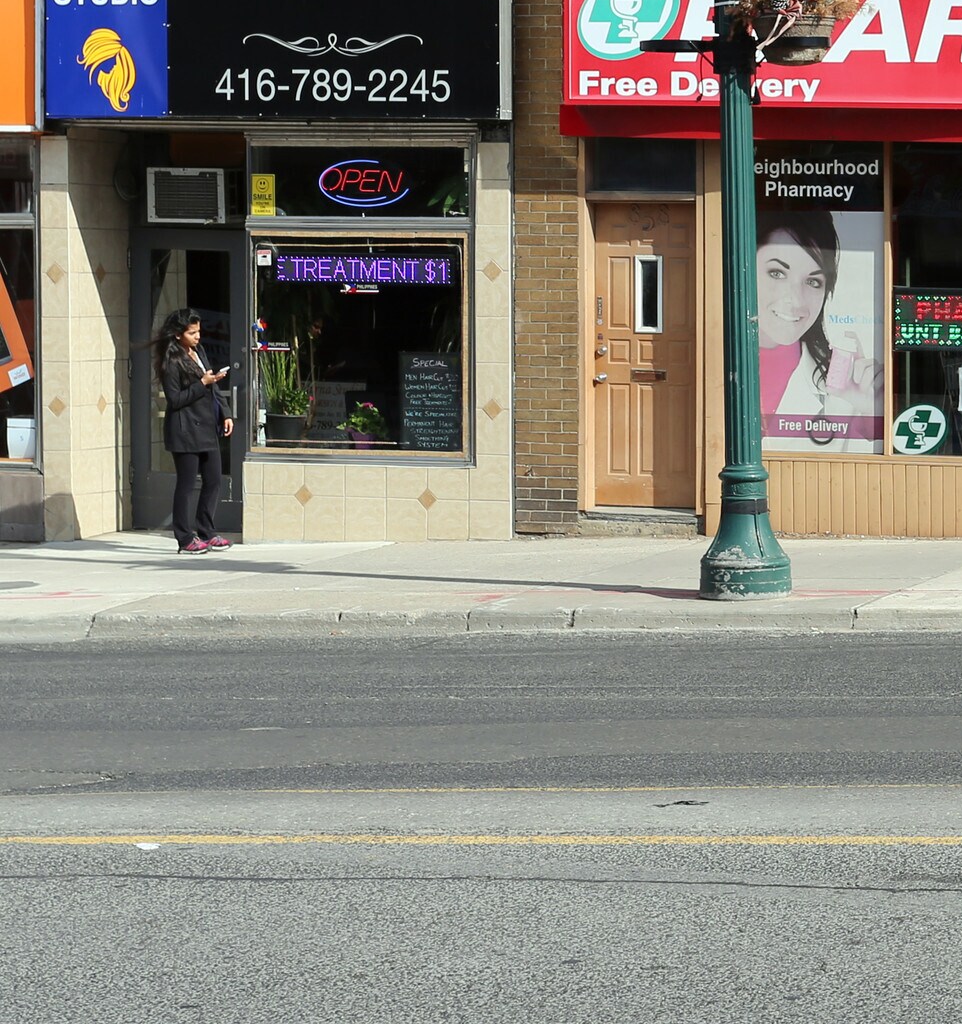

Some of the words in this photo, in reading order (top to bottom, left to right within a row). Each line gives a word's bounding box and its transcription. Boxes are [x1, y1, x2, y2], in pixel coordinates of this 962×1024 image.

[215, 68, 452, 103] 416-789-2245
[579, 71, 658, 97] Free
[671, 71, 820, 102] Deery
[754, 159, 879, 178] eighbourhood
[321, 167, 403, 193] OPEN
[765, 181, 854, 201] Pharmacy
[291, 259, 420, 280] TREATMENT
[412, 357, 448, 367] SPECIAL
[405, 373, 417, 381] MEN
[778, 419, 802, 431] Free
[805, 419, 849, 434] Delivery
